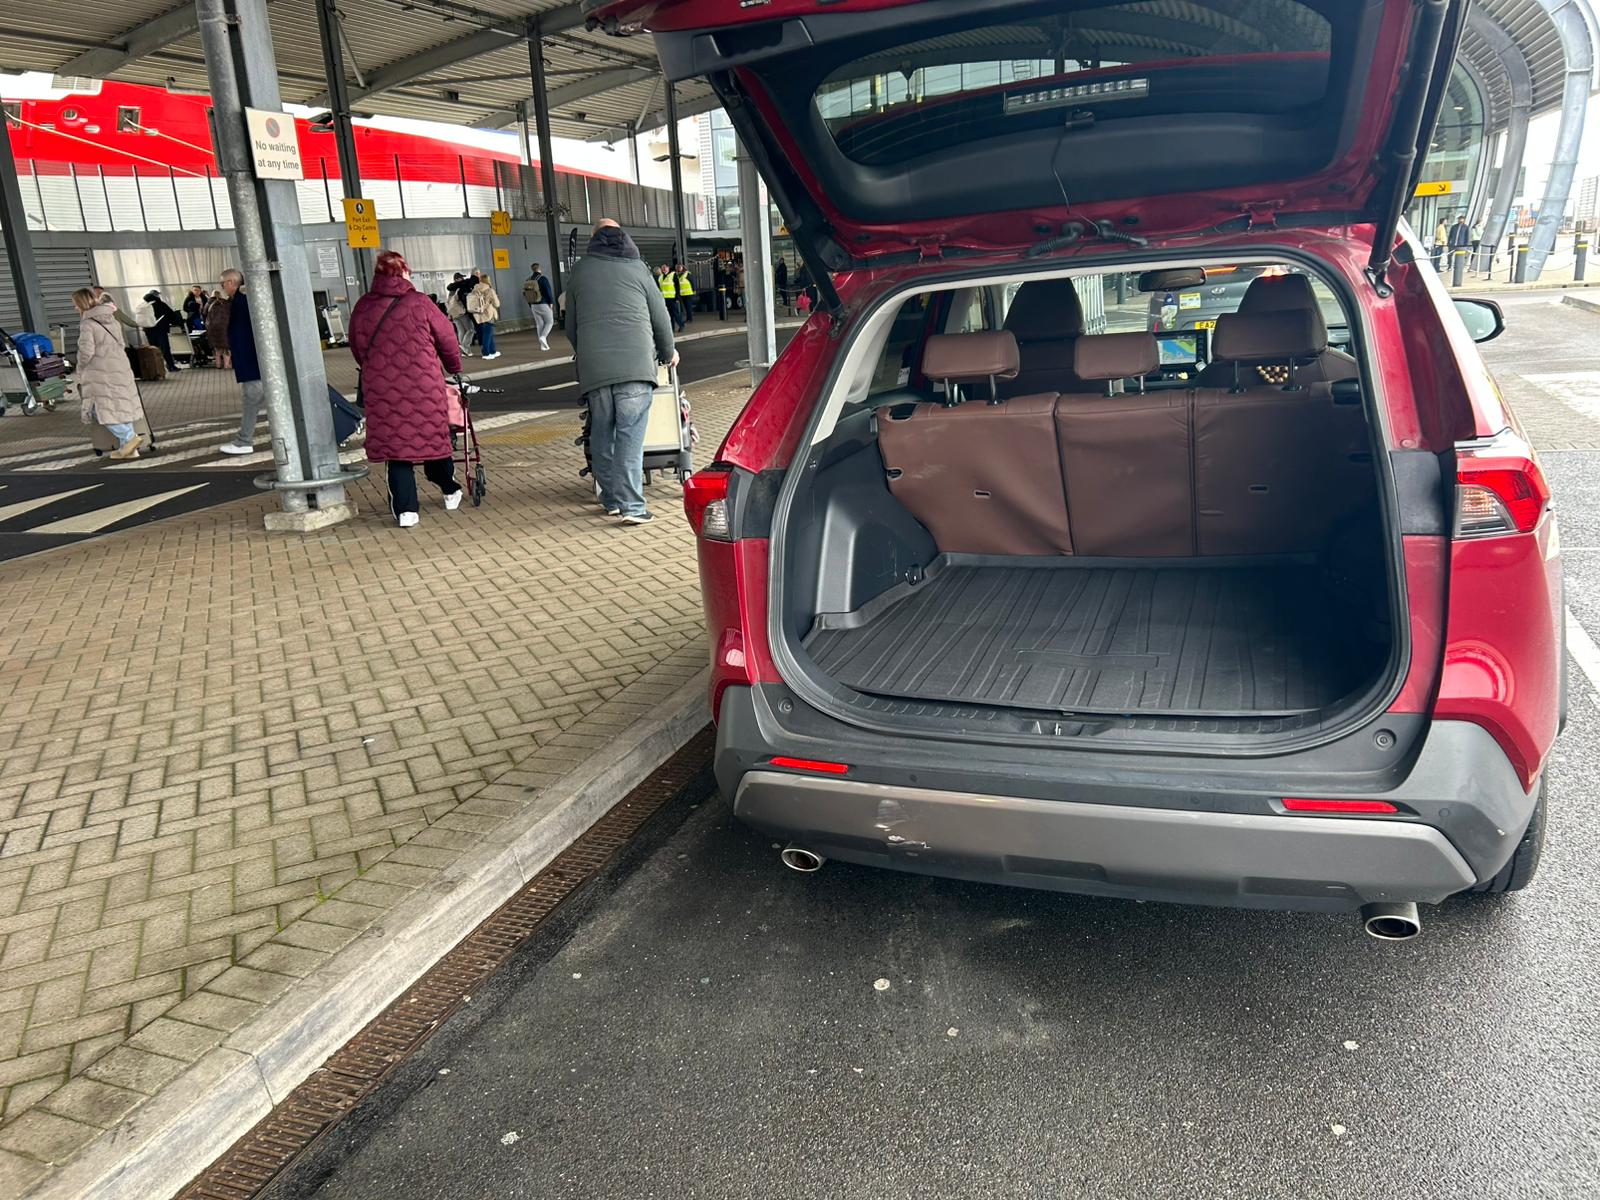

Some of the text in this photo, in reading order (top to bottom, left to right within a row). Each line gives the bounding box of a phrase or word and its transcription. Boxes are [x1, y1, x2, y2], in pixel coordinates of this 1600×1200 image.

[255, 141, 296, 155] No waiting
[258, 159, 299, 171] at any time
